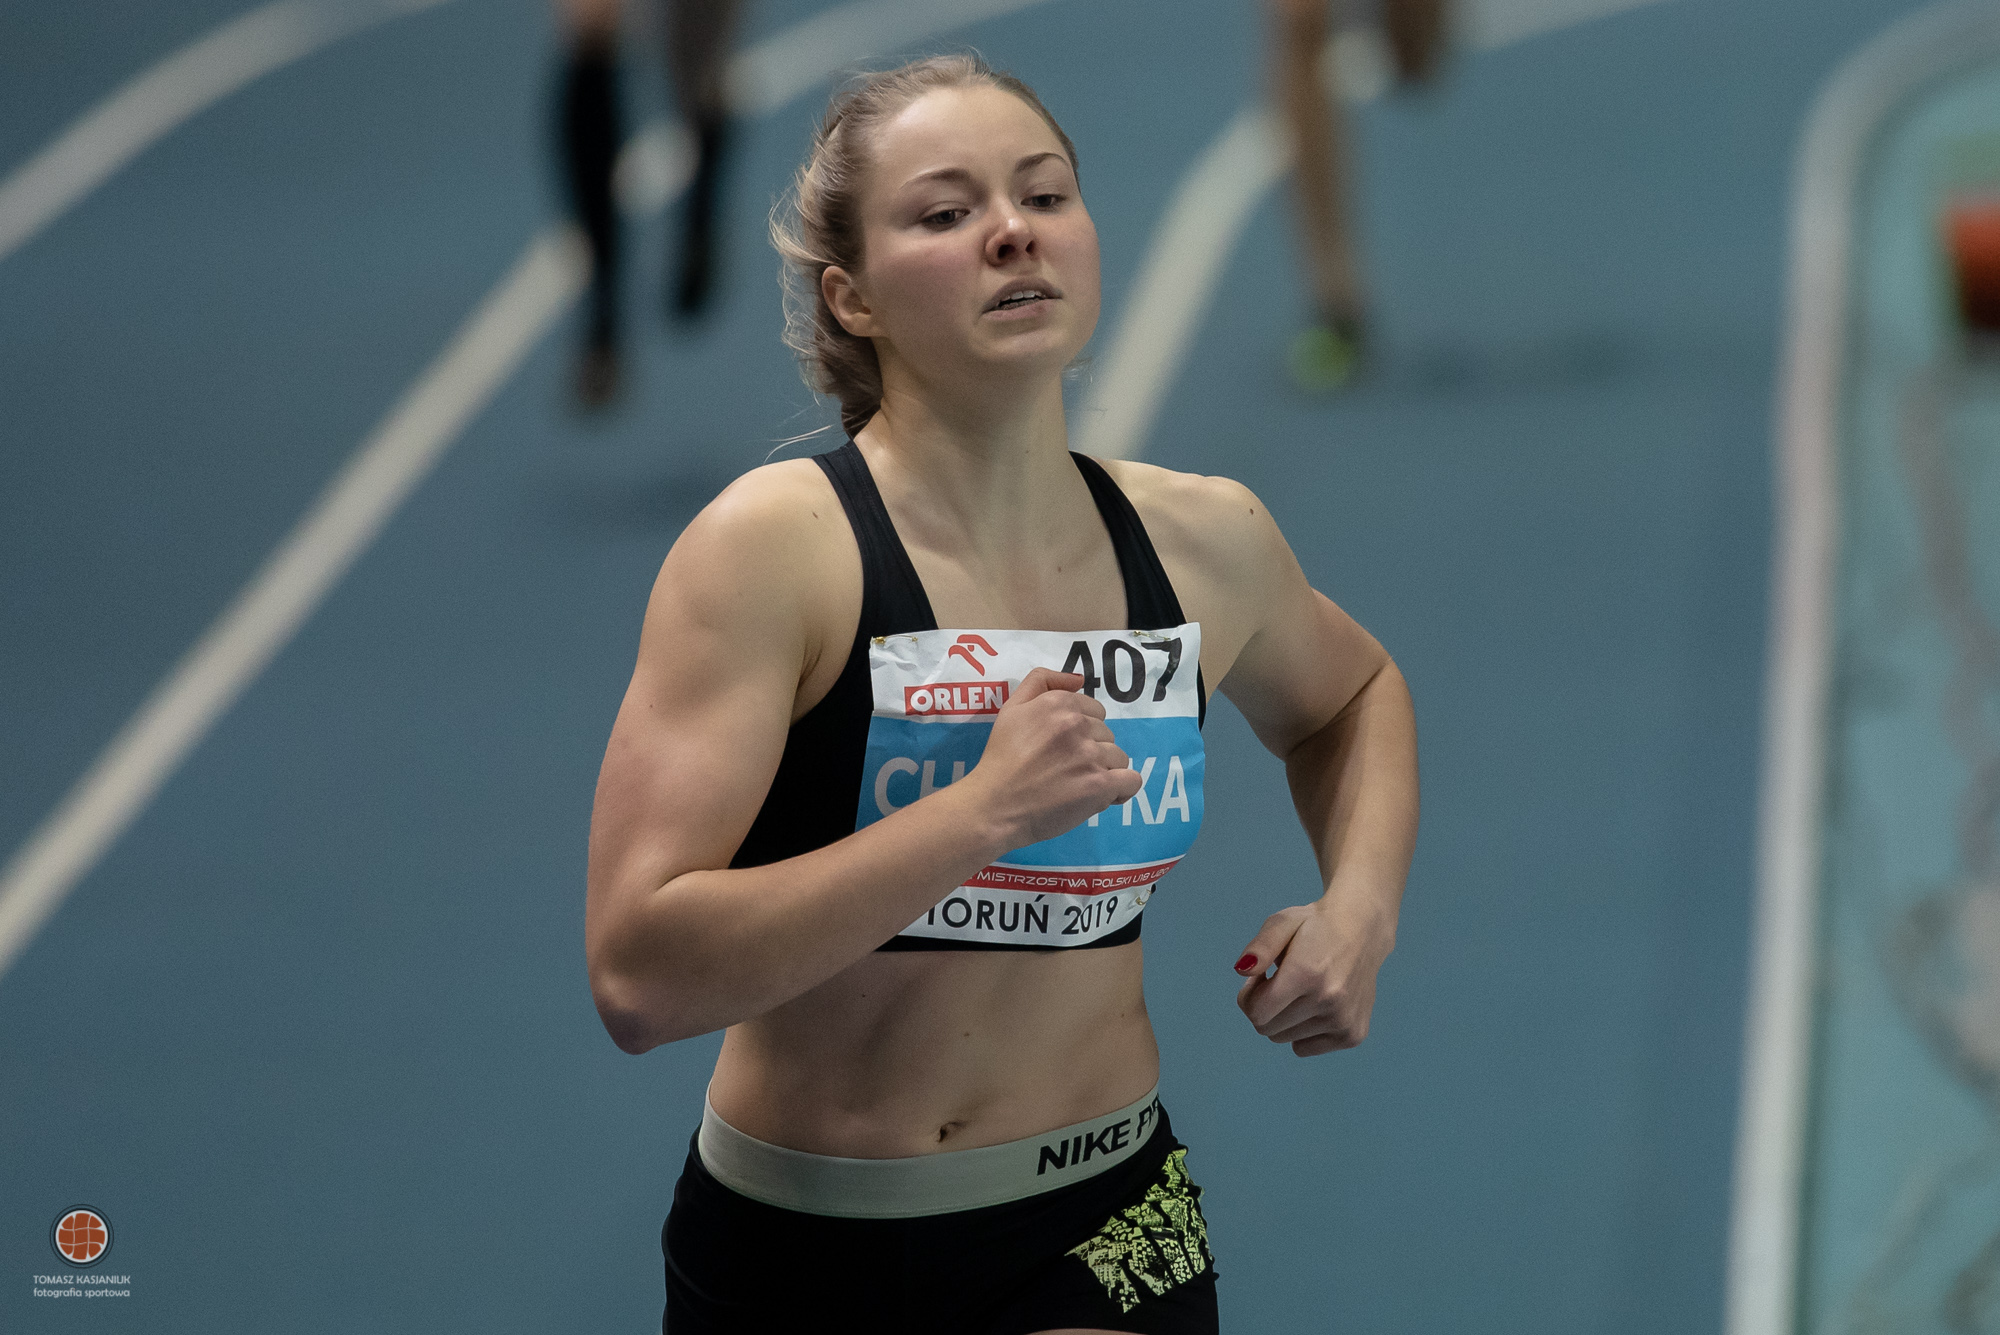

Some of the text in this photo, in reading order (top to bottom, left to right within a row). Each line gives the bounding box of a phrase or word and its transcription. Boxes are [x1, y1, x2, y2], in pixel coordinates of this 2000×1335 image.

[1060, 637, 1183, 704] 407
[910, 686, 1004, 711] ORLEN
[976, 870, 1088, 888] MISTRZOSTWA
[1091, 875, 1132, 889] POLSKI
[1061, 896, 1119, 935] 2019
[1036, 1117, 1132, 1177] NIKE
